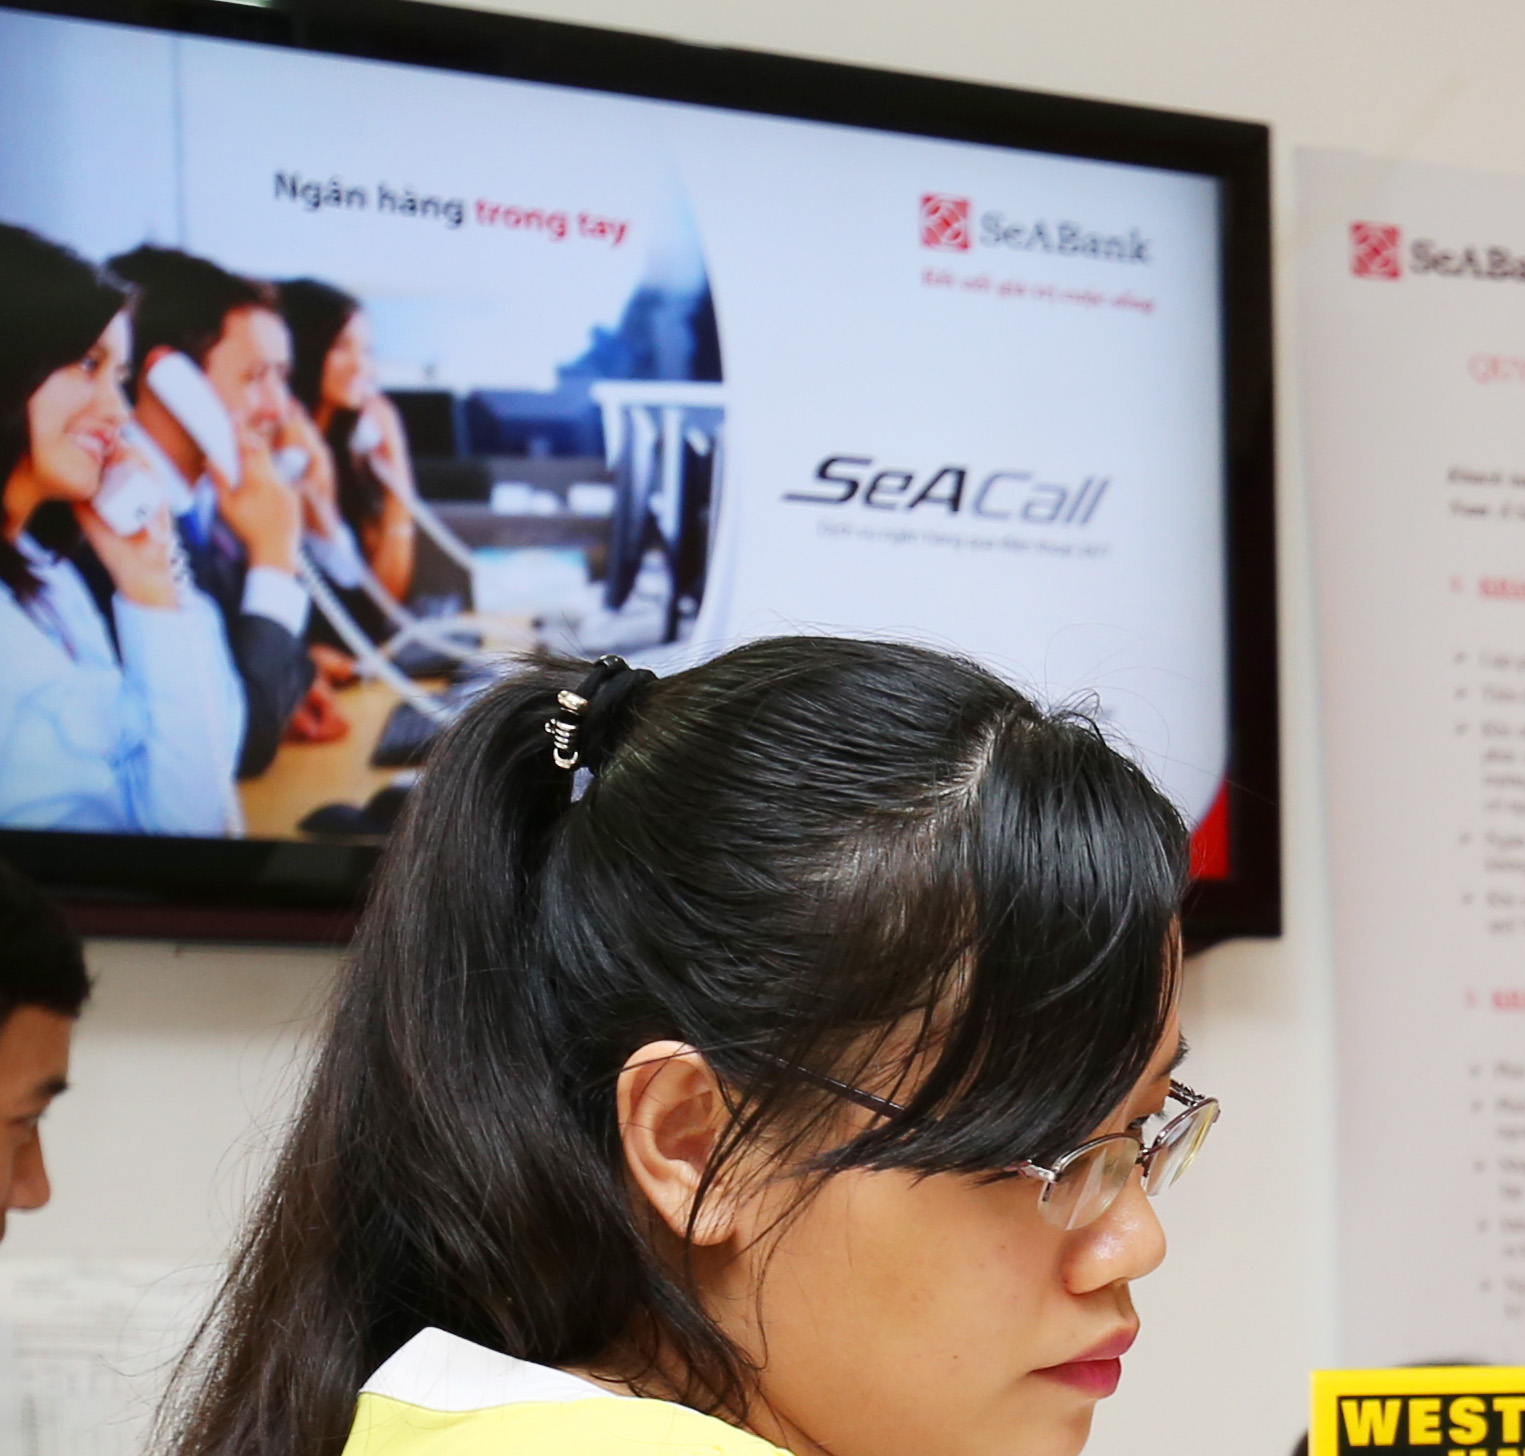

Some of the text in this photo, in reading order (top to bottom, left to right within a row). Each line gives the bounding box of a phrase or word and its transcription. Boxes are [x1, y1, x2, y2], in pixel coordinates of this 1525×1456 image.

[274, 172, 627, 248] Ngân hàng trong tay
[979, 209, 1152, 264] SeABank
[781, 454, 1111, 529] SeACall
